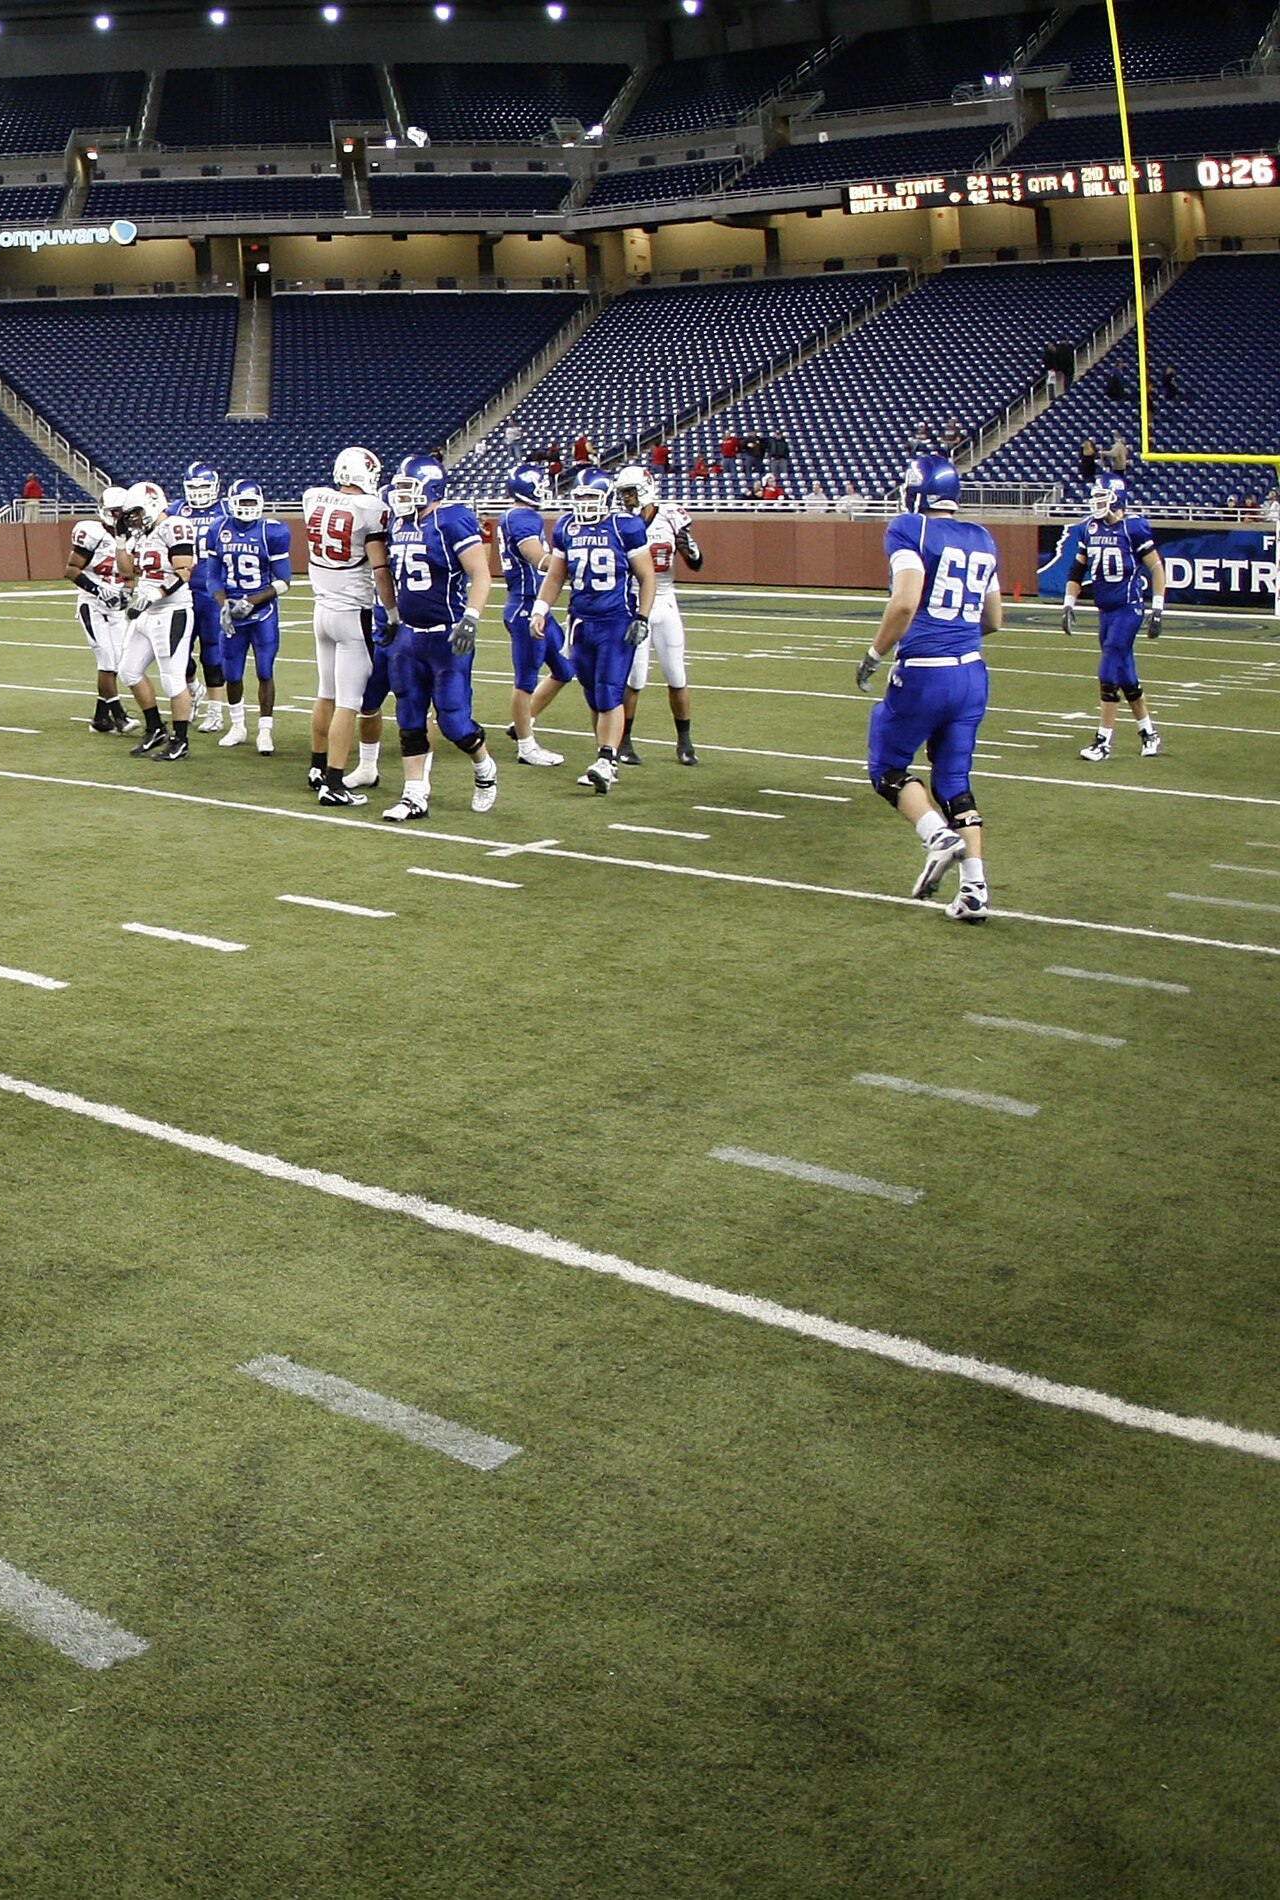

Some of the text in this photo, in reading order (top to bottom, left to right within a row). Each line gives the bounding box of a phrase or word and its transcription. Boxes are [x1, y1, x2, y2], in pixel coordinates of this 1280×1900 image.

[967, 175, 988, 190] 24
[1011, 173, 1021, 187] 2
[1027, 172, 1075, 193] QTR 4
[1081, 166, 1104, 182] 2ND
[1147, 163, 1161, 178] 12
[1197, 158, 1273, 187] 0:26
[849, 178, 945, 200] BALL STATE
[968, 190, 990, 205] 42
[1083, 181, 1114, 197] BALL
[1148, 178, 1163, 193] 18
[850, 196, 918, 214] BUFFALO
[173, 525, 193, 541] 92
[307, 506, 354, 562] 49
[223, 554, 261, 589] 19
[390, 544, 433, 591] 75
[567, 548, 617, 591] 79
[1087, 547, 1123, 583] 70
[927, 546, 997, 623] 69
